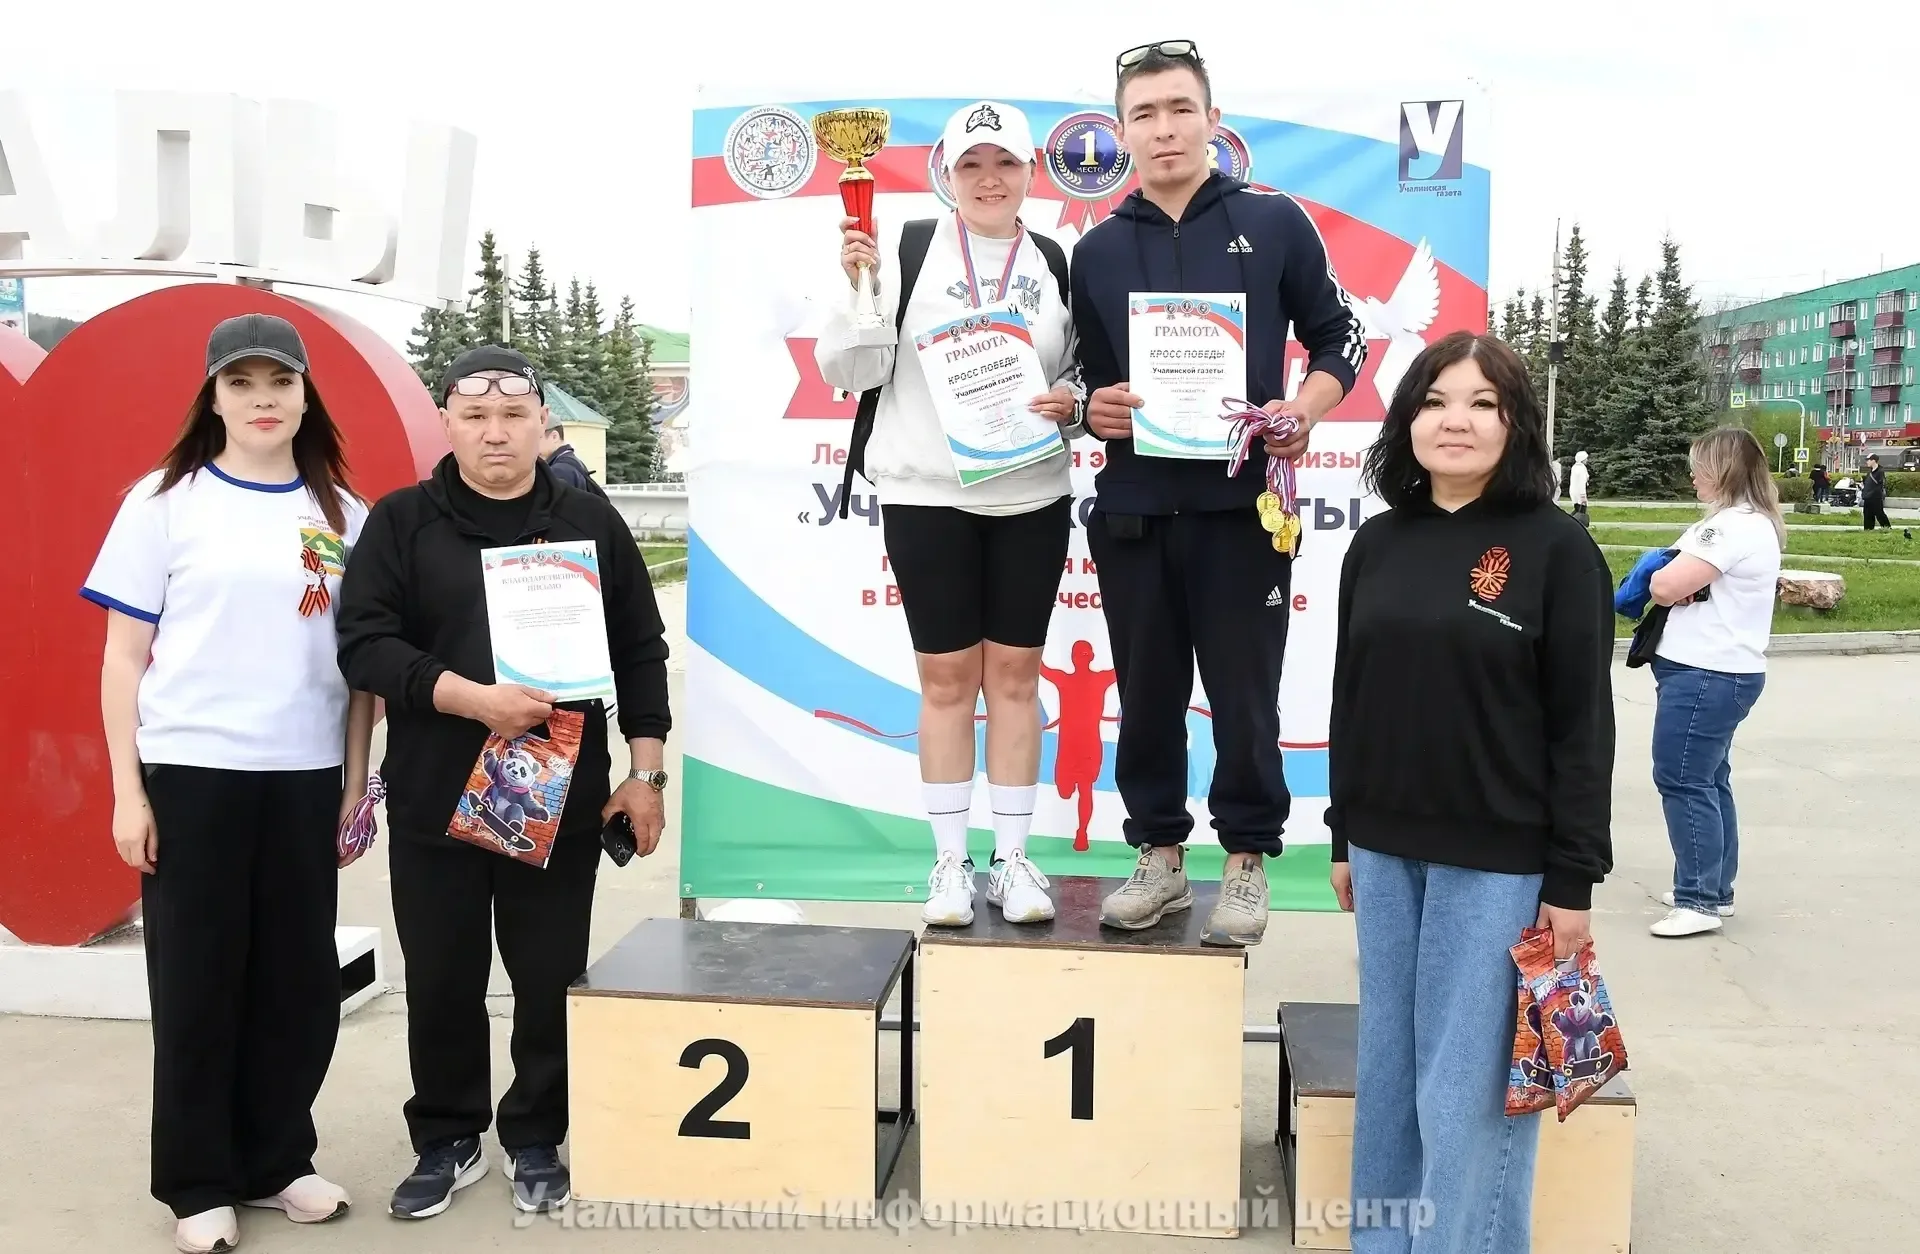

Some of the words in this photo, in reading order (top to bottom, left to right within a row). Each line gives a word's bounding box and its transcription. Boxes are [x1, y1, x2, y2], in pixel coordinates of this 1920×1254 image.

[1079, 131, 1099, 166] 1
[1399, 183, 1447, 193] Учалинская
[1154, 326, 1220, 337] ГРАМОТА
[945, 335, 1008, 363] ГРАМОТА
[1150, 349, 1181, 358] КРОСС
[1184, 349, 1225, 359] ПОБЕДЫ
[948, 368, 979, 385] КРОСС
[981, 354, 1019, 374] ПОБЕДЫ
[1152, 366, 1196, 374] Учалинской
[862, 589, 877, 605] в
[1044, 1017, 1095, 1120] 1
[678, 1038, 750, 1140] 2
